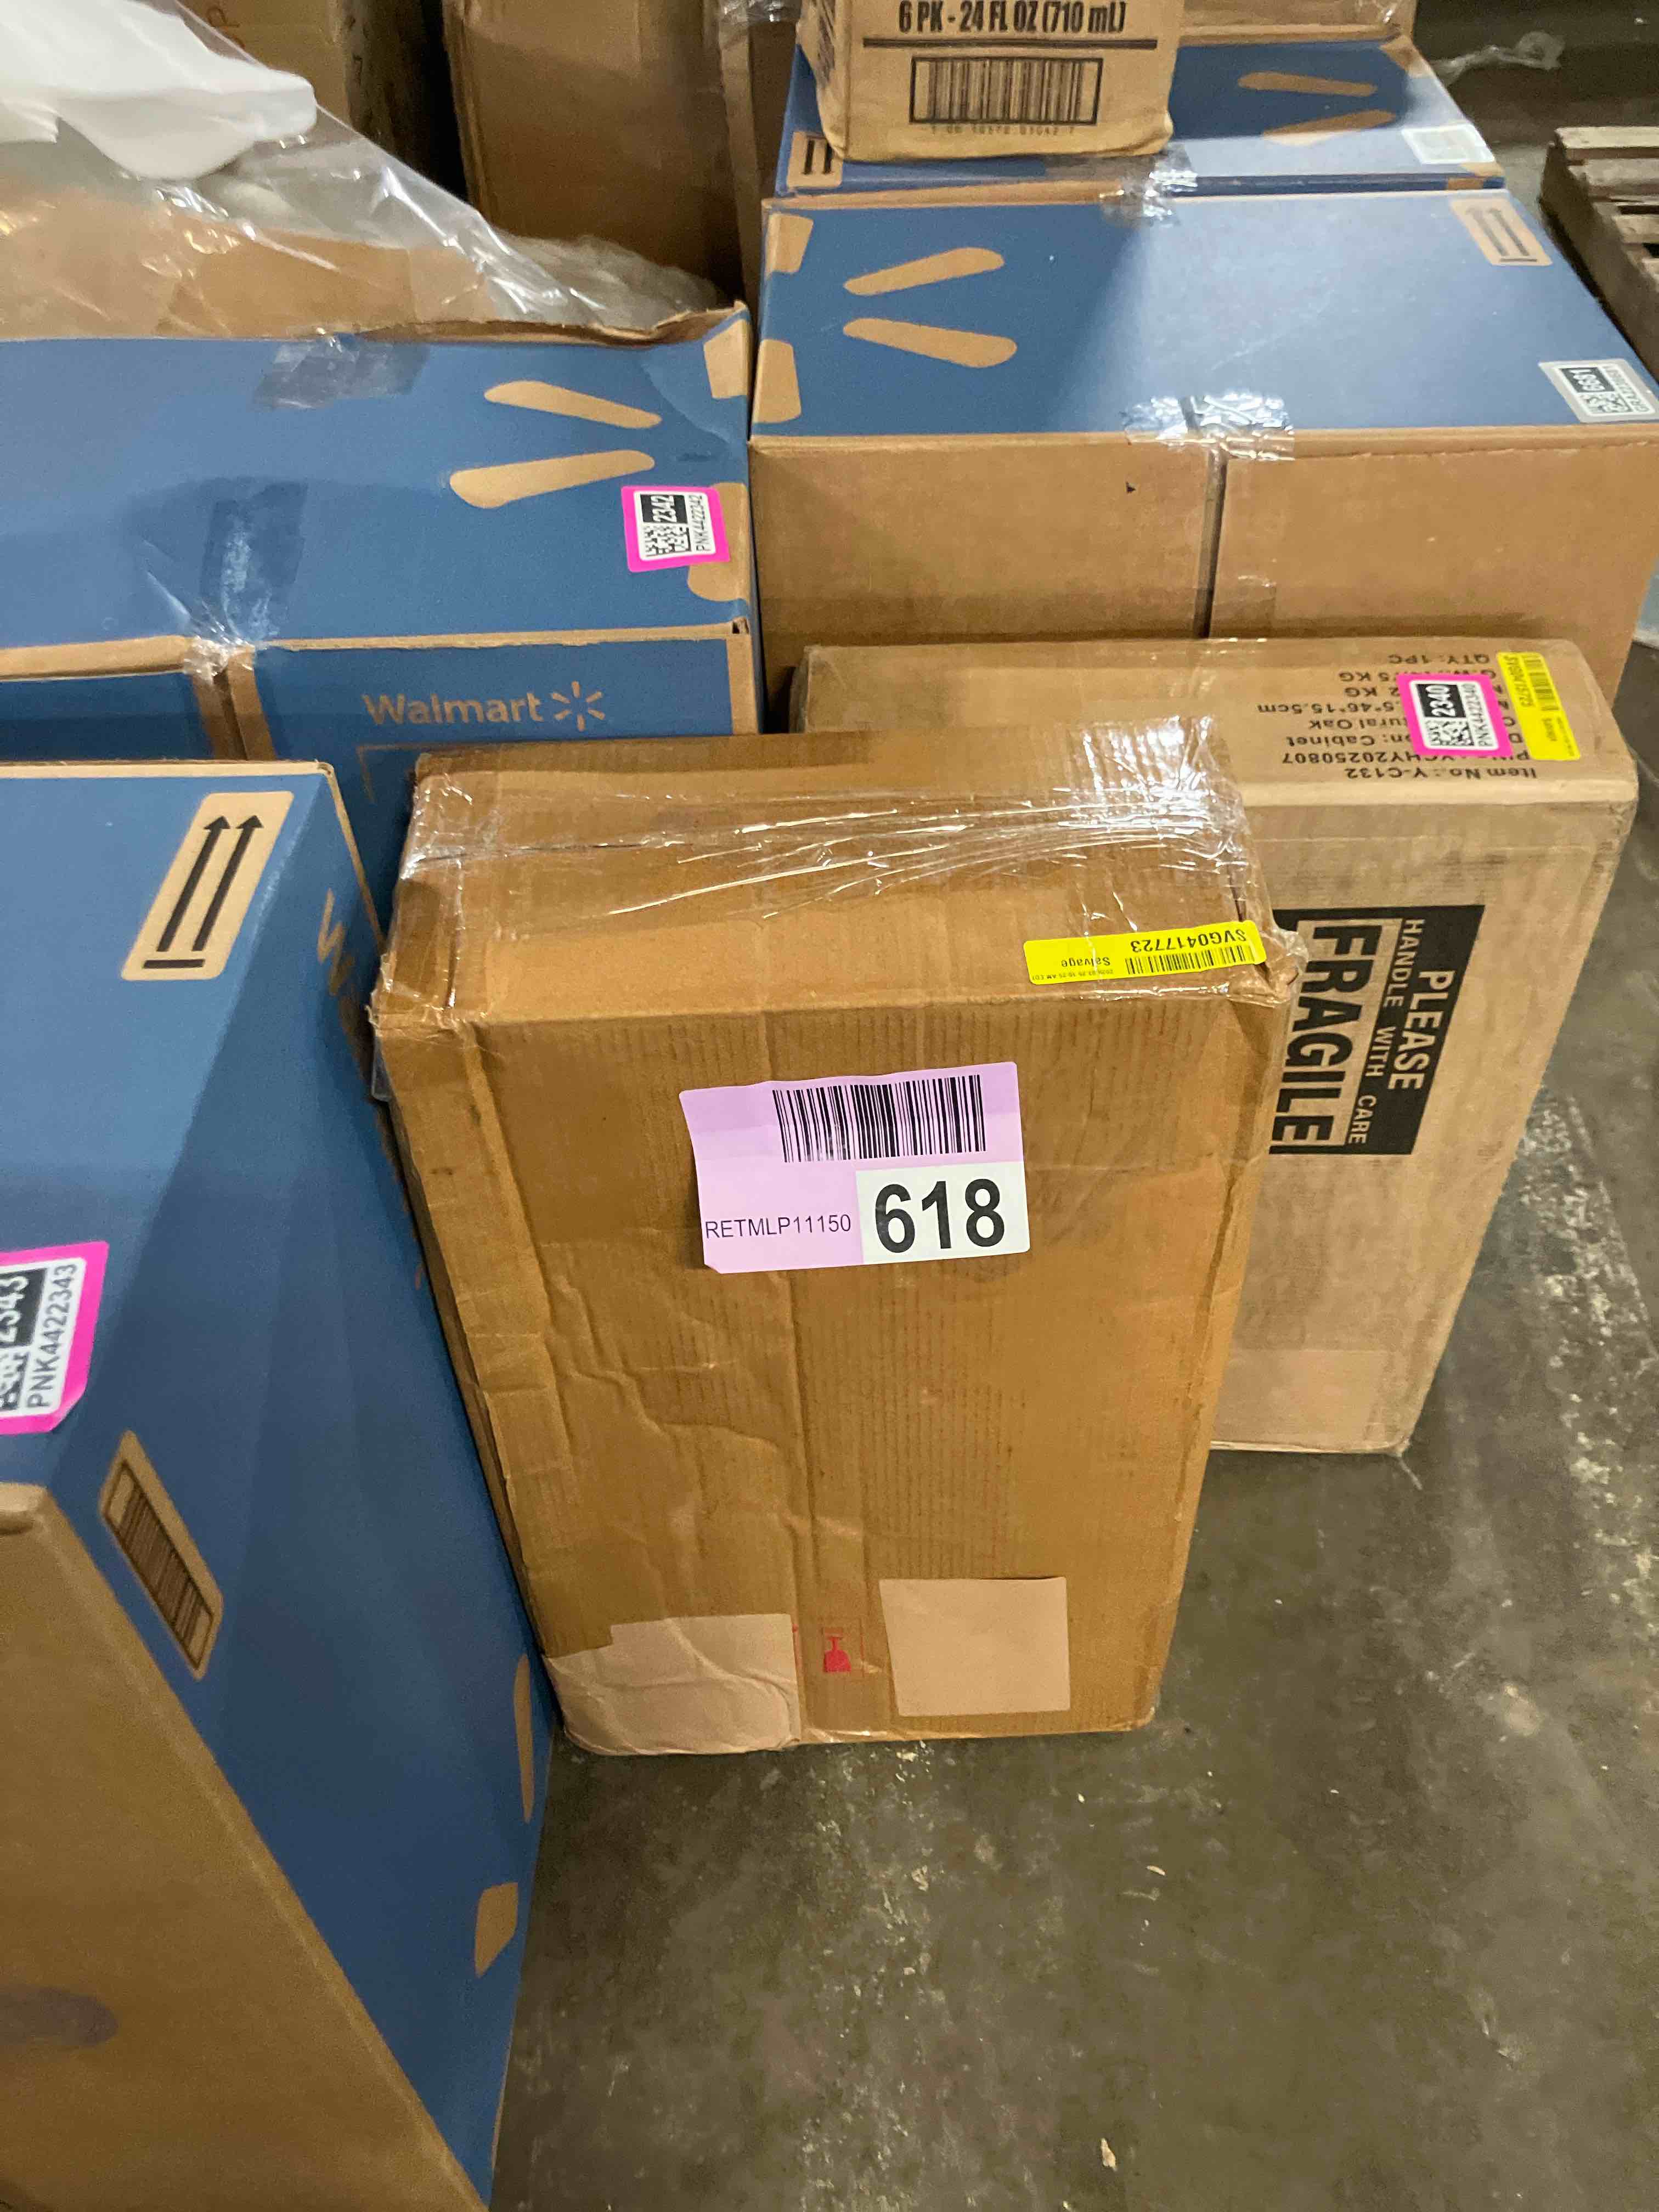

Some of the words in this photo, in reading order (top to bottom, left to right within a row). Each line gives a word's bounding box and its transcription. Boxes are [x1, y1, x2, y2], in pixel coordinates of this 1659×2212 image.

[898, 1, 912, 33] 6
[917, 1, 943, 32] PK
[960, 1, 984, 32] 24
[989, 1, 1008, 32] FL
[1013, 1, 1038, 32] OZ
[1043, 1, 1084, 33] (710
[1087, 1, 1127, 33] mL)
[650, 495, 678, 523] 2342
[1388, 653, 1431, 664] 1PC
[1338, 671, 1372, 682] KG
[1344, 687, 1378, 697] KG
[1425, 685, 1455, 717] 2340
[361, 692, 544, 725] Walmart
[1309, 719, 1353, 730] Oak
[1286, 735, 1375, 747] Cabinet
[1345, 766, 1428, 779] Y-C132
[1487, 767, 1537, 780] Item
[1130, 928, 1248, 953] SVG0417723
[1061, 956, 1111, 968] Salvage
[1383, 918, 1425, 1008] HANDLE
[1272, 925, 1383, 1141] FRAGILE
[1387, 970, 1456, 1090] PLEASE
[1365, 1026, 1396, 1077] WITH
[1348, 1094, 1376, 1144] CARE
[705, 1214, 852, 1239] RETMLP11150
[874, 1178, 1006, 1253] 618
[26, 1263, 77, 1408] PNK4422343
